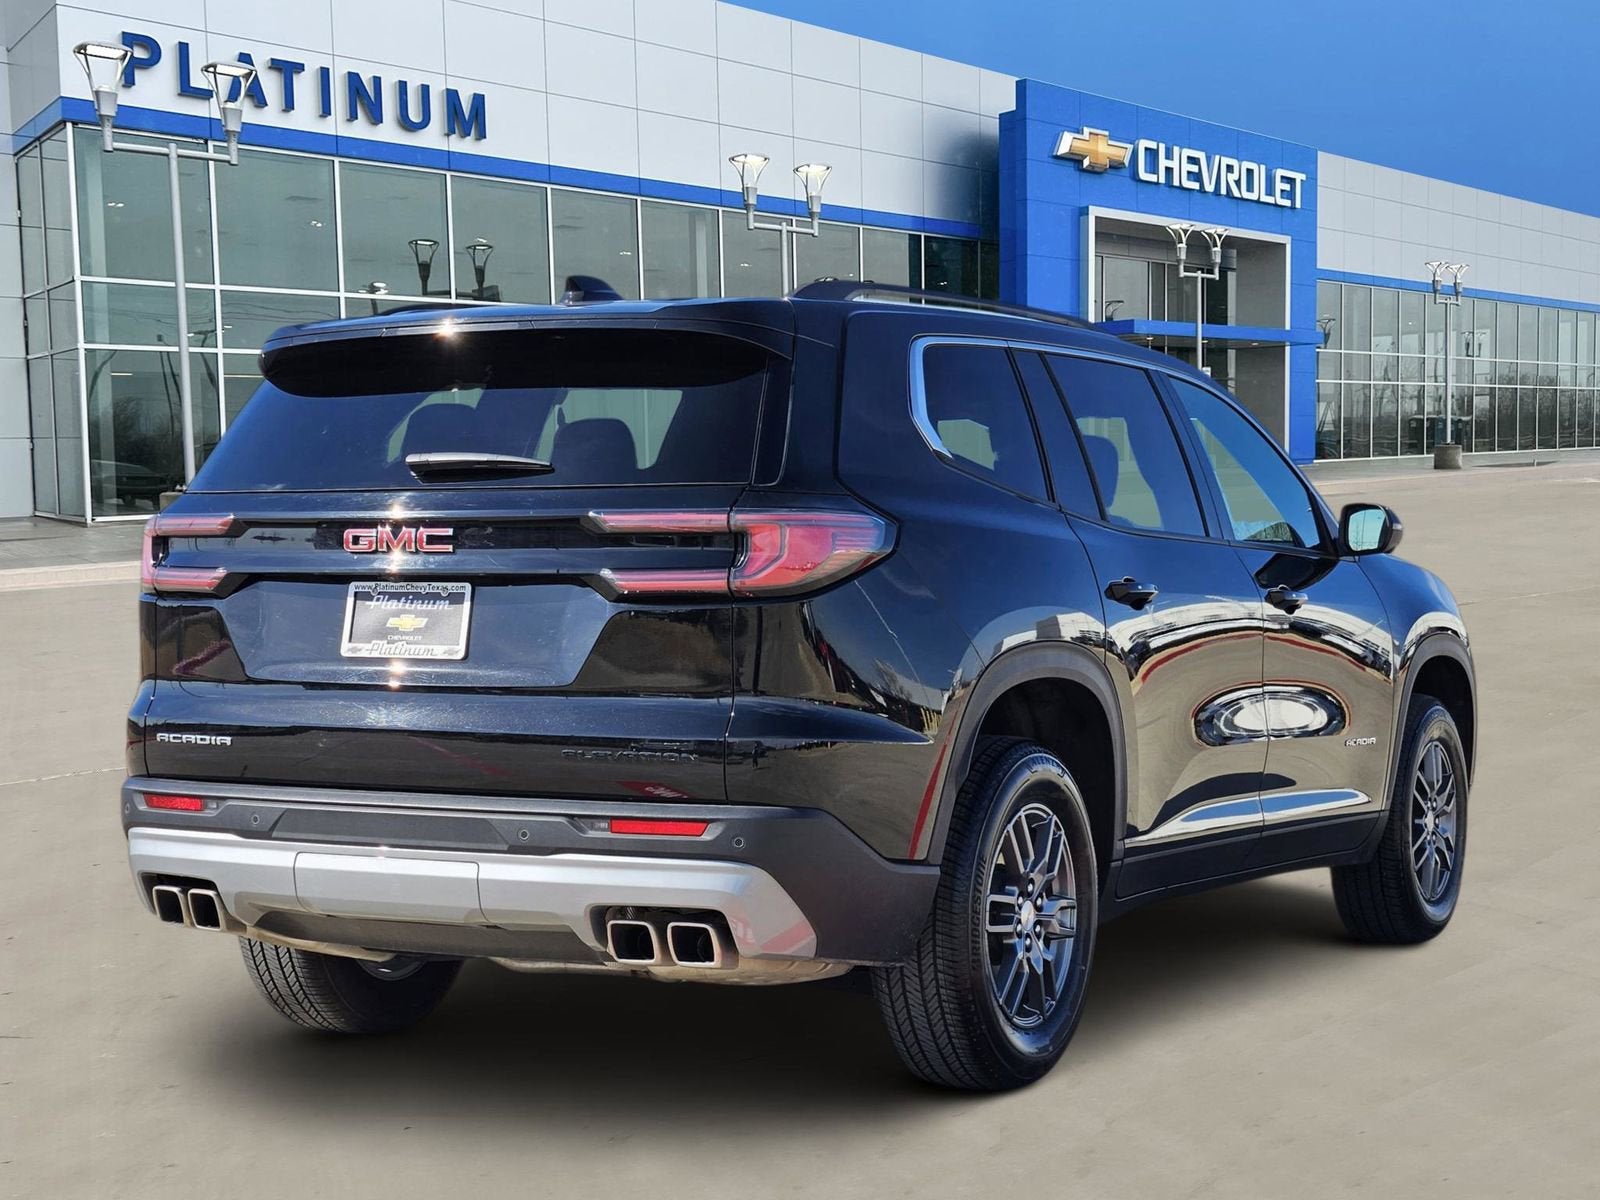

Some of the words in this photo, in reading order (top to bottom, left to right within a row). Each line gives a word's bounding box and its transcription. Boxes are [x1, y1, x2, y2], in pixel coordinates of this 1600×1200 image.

[122, 31, 487, 141] PLATINUM
[1136, 139, 1306, 209] CHEVROLET
[343, 526, 454, 552] GMC
[365, 595, 453, 610] Platinum
[365, 642, 438, 656] Platinum
[156, 733, 232, 746] ACADIA
[1345, 737, 1377, 747] ACADIA
